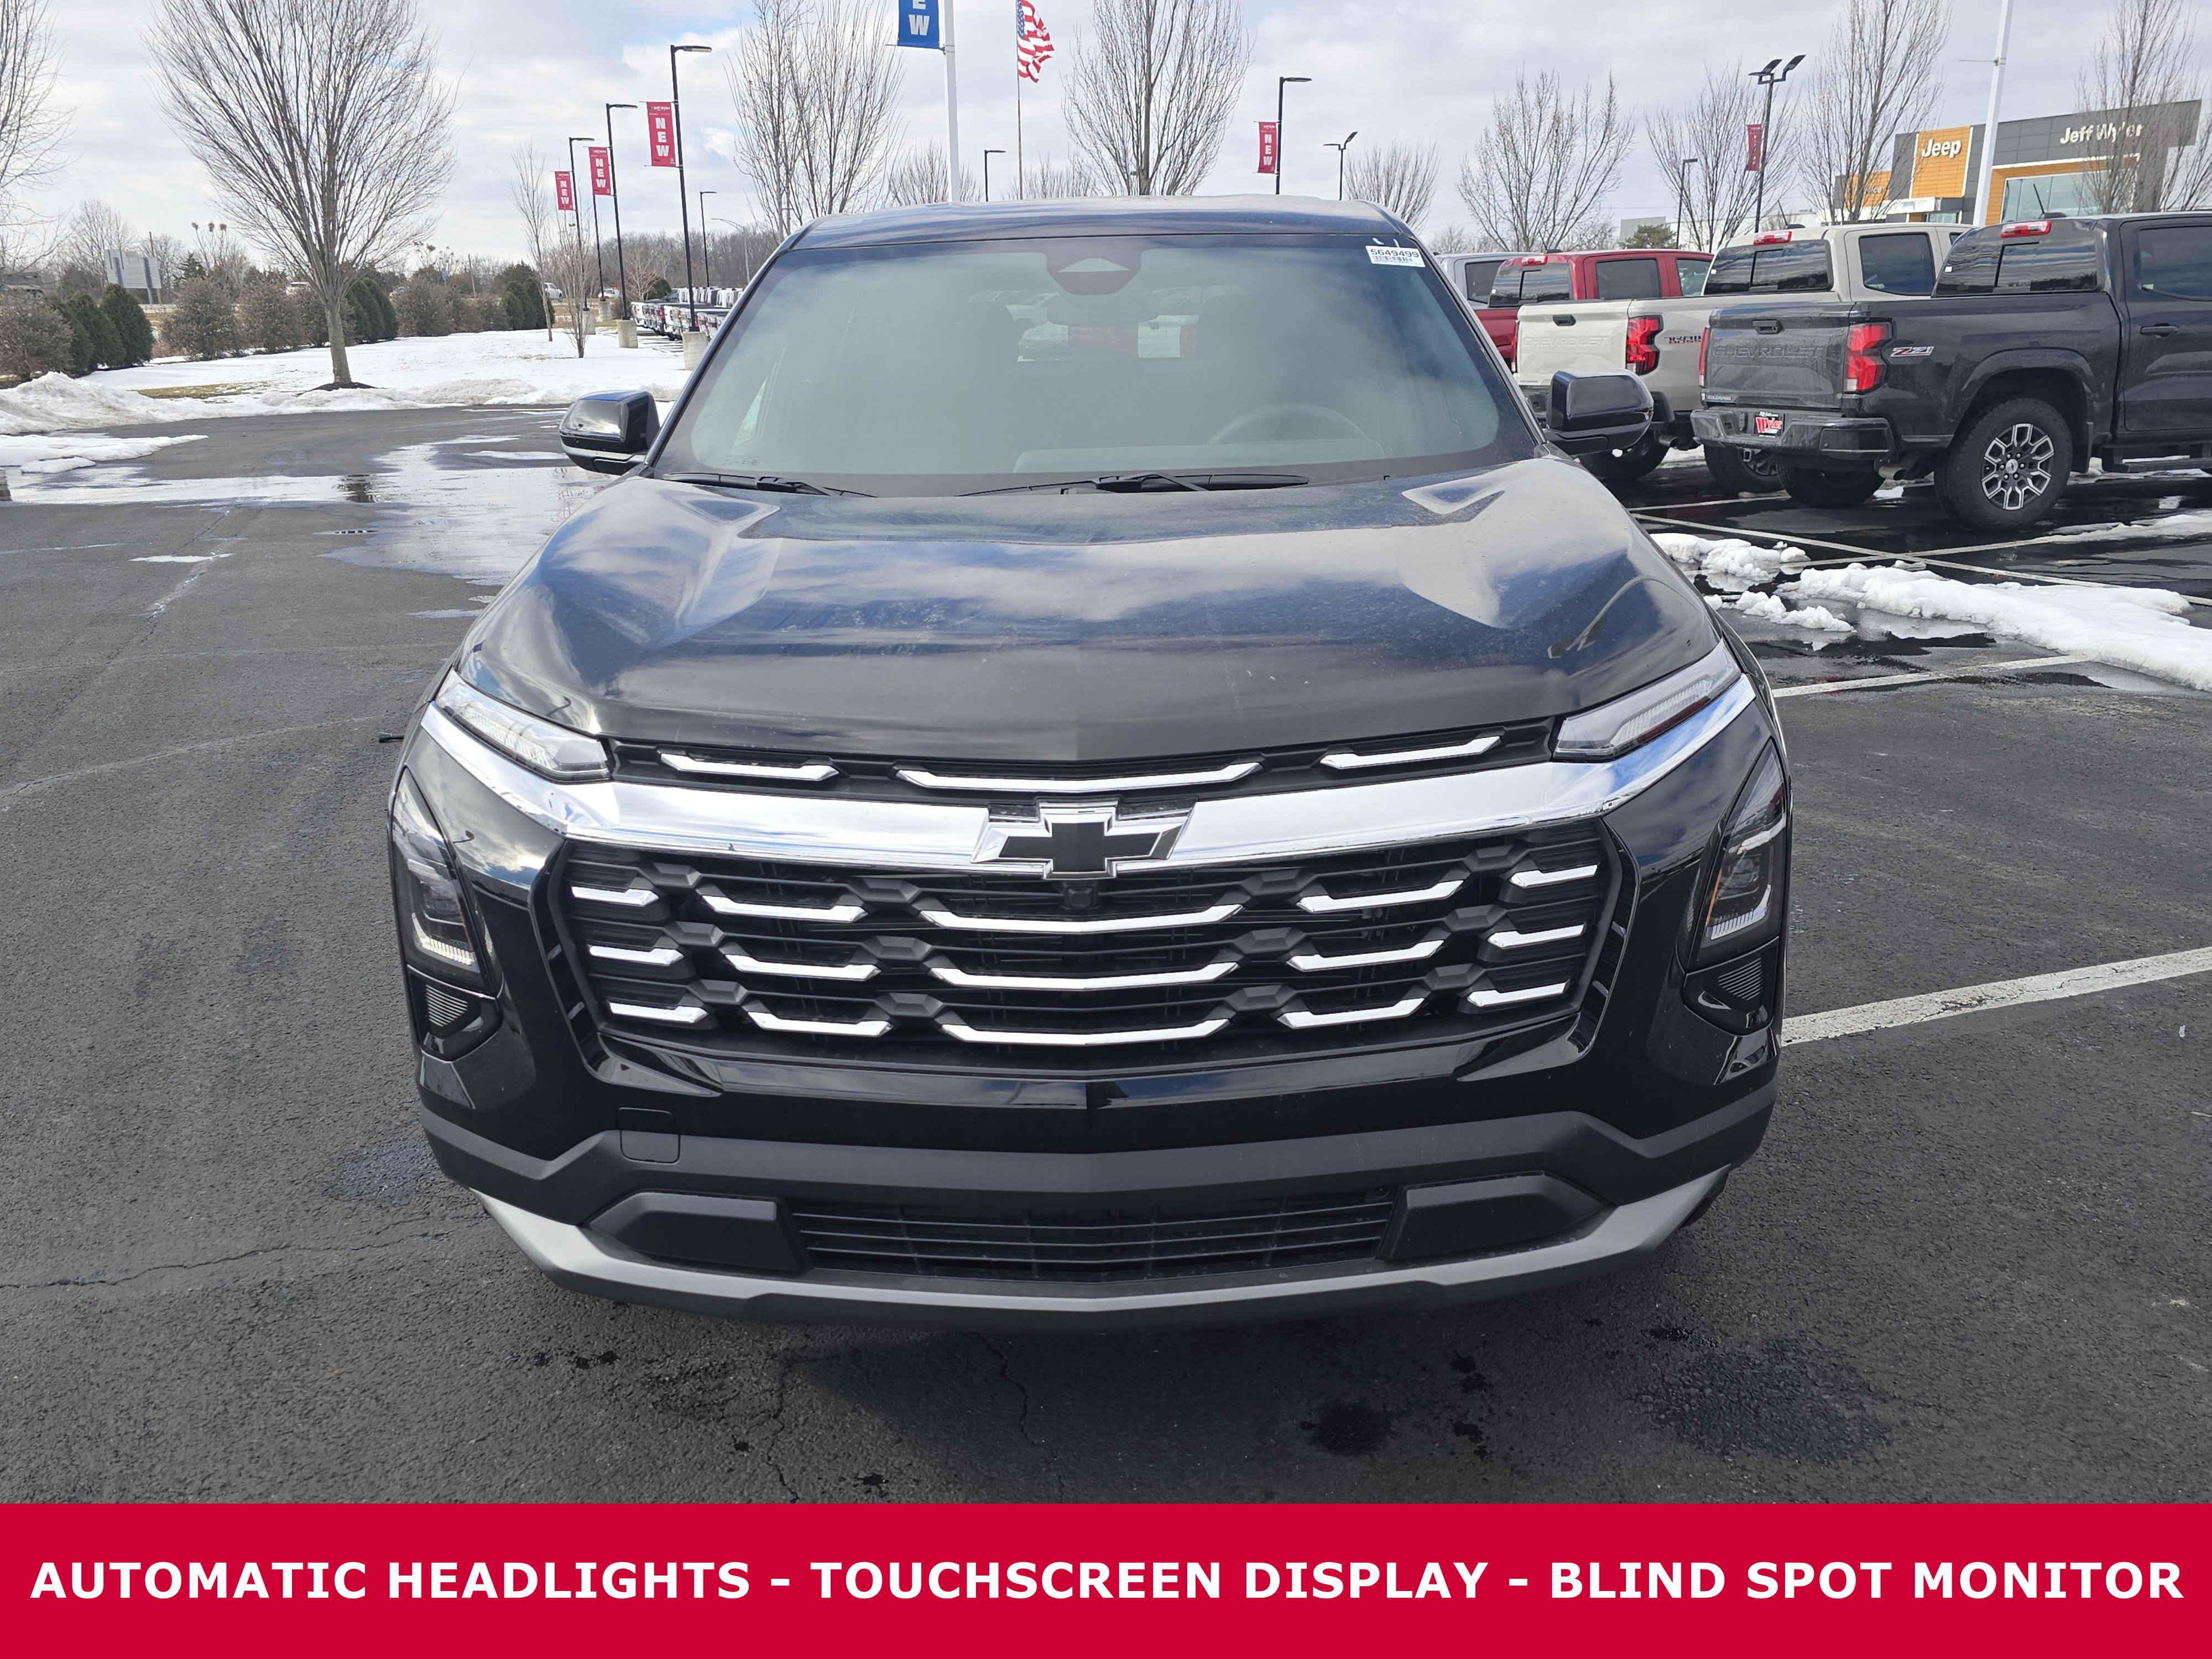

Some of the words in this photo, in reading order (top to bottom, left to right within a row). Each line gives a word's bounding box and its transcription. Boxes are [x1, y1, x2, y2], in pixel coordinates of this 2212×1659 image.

[655, 117, 669, 156] NEW
[2060, 125, 2094, 144] Jeff
[1263, 134, 1273, 165] NEW
[1921, 139, 1961, 159] Jeep
[595, 158, 606, 188] NEW
[560, 180, 569, 204] NEW
[1371, 249, 1419, 258] 5649499
[1524, 336, 1609, 347] CHEVROLET
[1714, 347, 1824, 358] CHEVROLET
[1890, 346, 1934, 357] Z71
